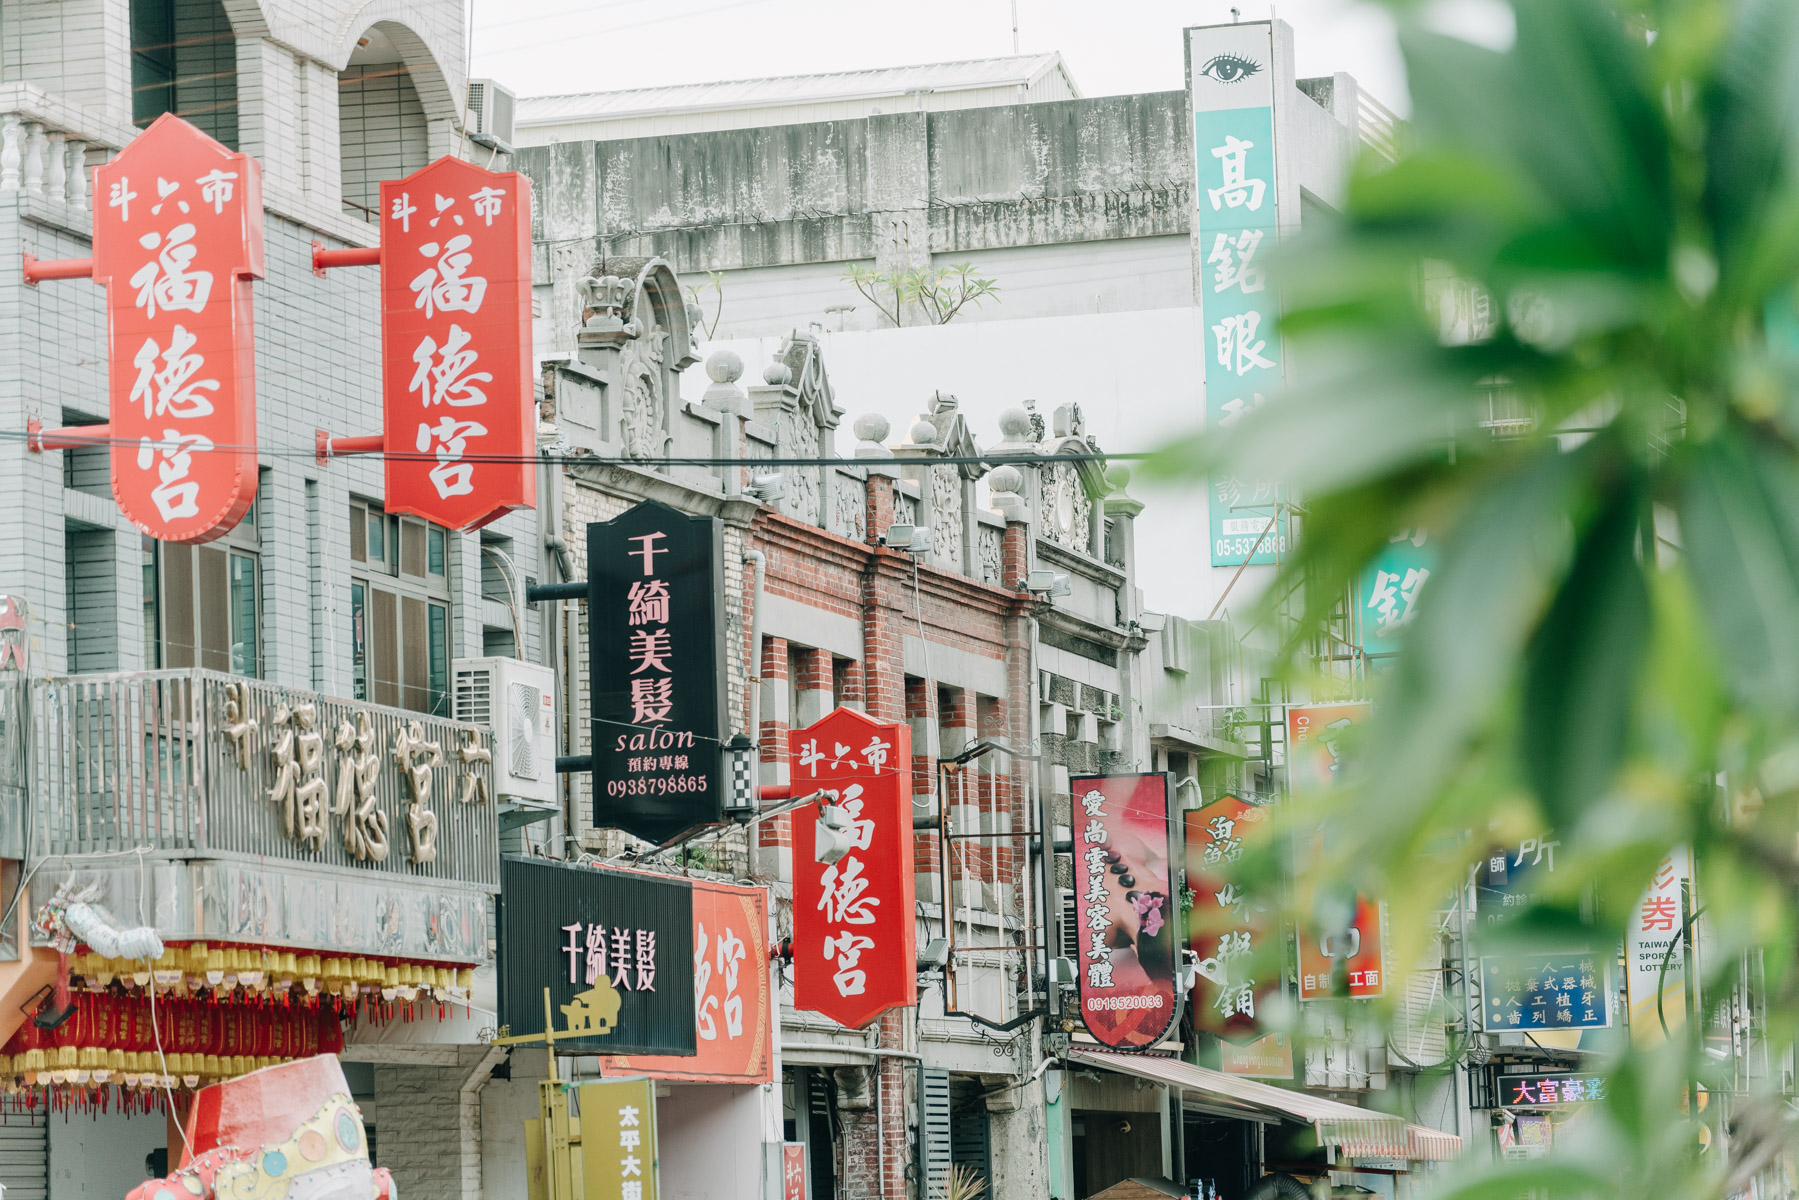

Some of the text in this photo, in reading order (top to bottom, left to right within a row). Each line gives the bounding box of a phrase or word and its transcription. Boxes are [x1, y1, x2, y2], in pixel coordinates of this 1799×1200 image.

[108, 169, 239, 222] 斗六市
[391, 186, 507, 233] 斗六市
[1207, 135, 1276, 427] 高銘眼
[128, 223, 221, 523] 福德宮
[408, 234, 494, 500] 福德宮
[627, 531, 674, 724] 千綺美髮
[614, 723, 696, 752] salon
[799, 736, 892, 778] 斗六市
[607, 773, 708, 798] 0938798865
[626, 754, 690, 772] 預約專線
[1081, 788, 1116, 988] 愛尚雲美容美體
[561, 920, 656, 992] 千綺美髮
[1304, 970, 1379, 990] 自制工面
[1086, 994, 1164, 1011] 0913520033
[1506, 991, 1596, 1007] 人工植牙
[618, 1105, 643, 1200] 太平大街
